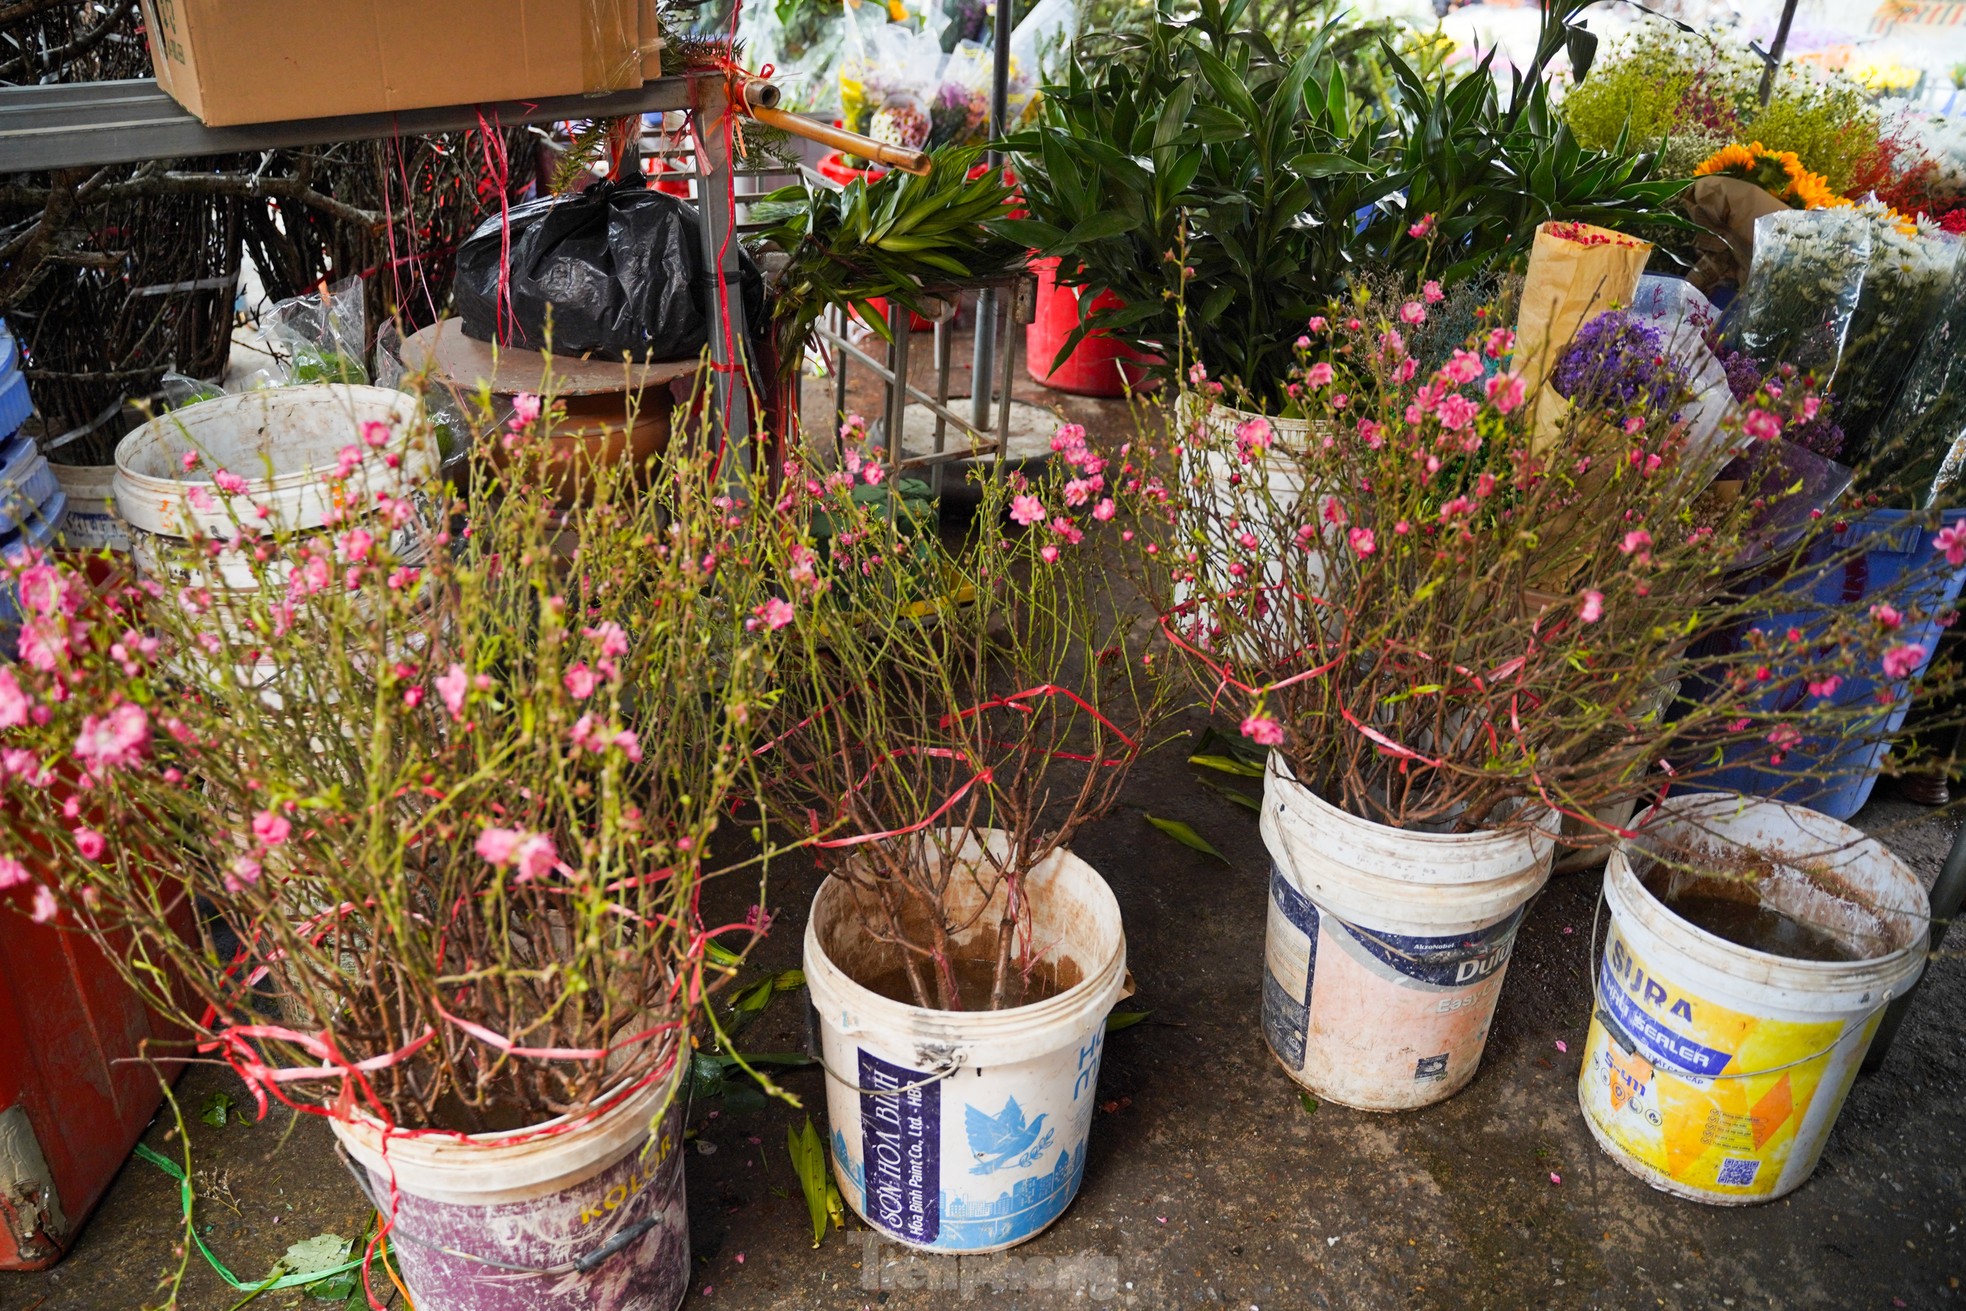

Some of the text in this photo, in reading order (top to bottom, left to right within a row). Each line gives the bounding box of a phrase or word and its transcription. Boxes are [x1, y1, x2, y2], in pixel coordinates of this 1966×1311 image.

[1413, 942, 1455, 951] AkzoNobel
[1632, 1012, 1710, 1068] SEALER
[907, 1115, 923, 1137] Ltd.
[869, 1069, 903, 1229] SƠN HÒA BÌNH
[908, 1140, 924, 1159] Co.,
[578, 1132, 672, 1225] KOLOR
[908, 1159, 923, 1188] Paint
